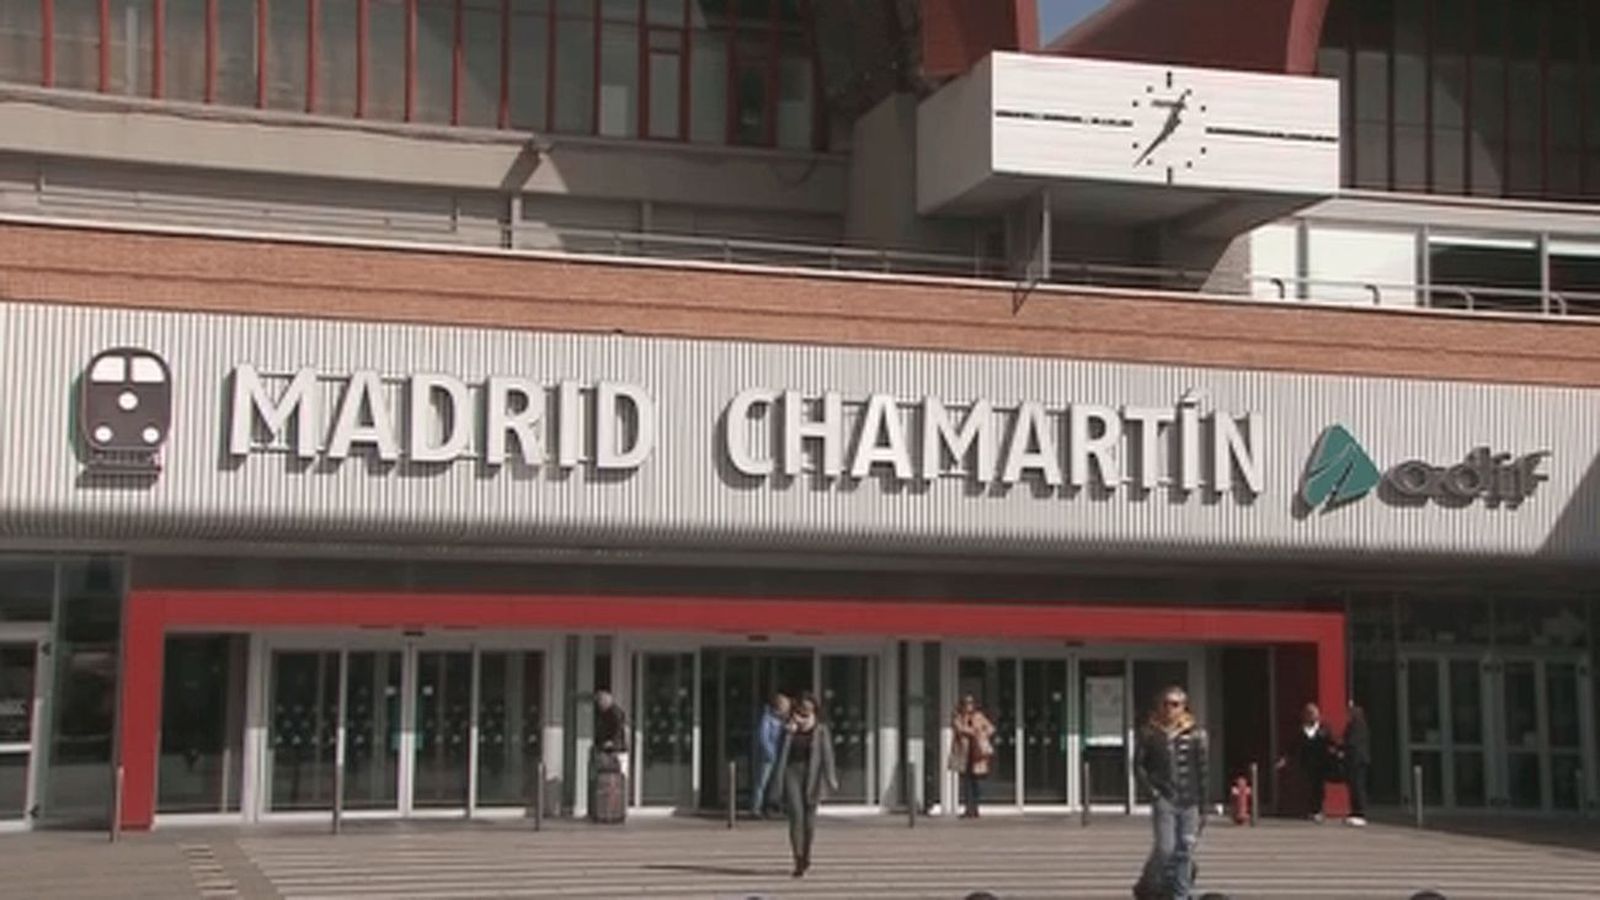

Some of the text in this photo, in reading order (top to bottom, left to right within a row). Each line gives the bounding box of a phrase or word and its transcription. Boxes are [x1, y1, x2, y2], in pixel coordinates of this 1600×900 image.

[229, 364, 1264, 496] MADRID CHAMARTÍN
[1380, 446, 1552, 505] adif
